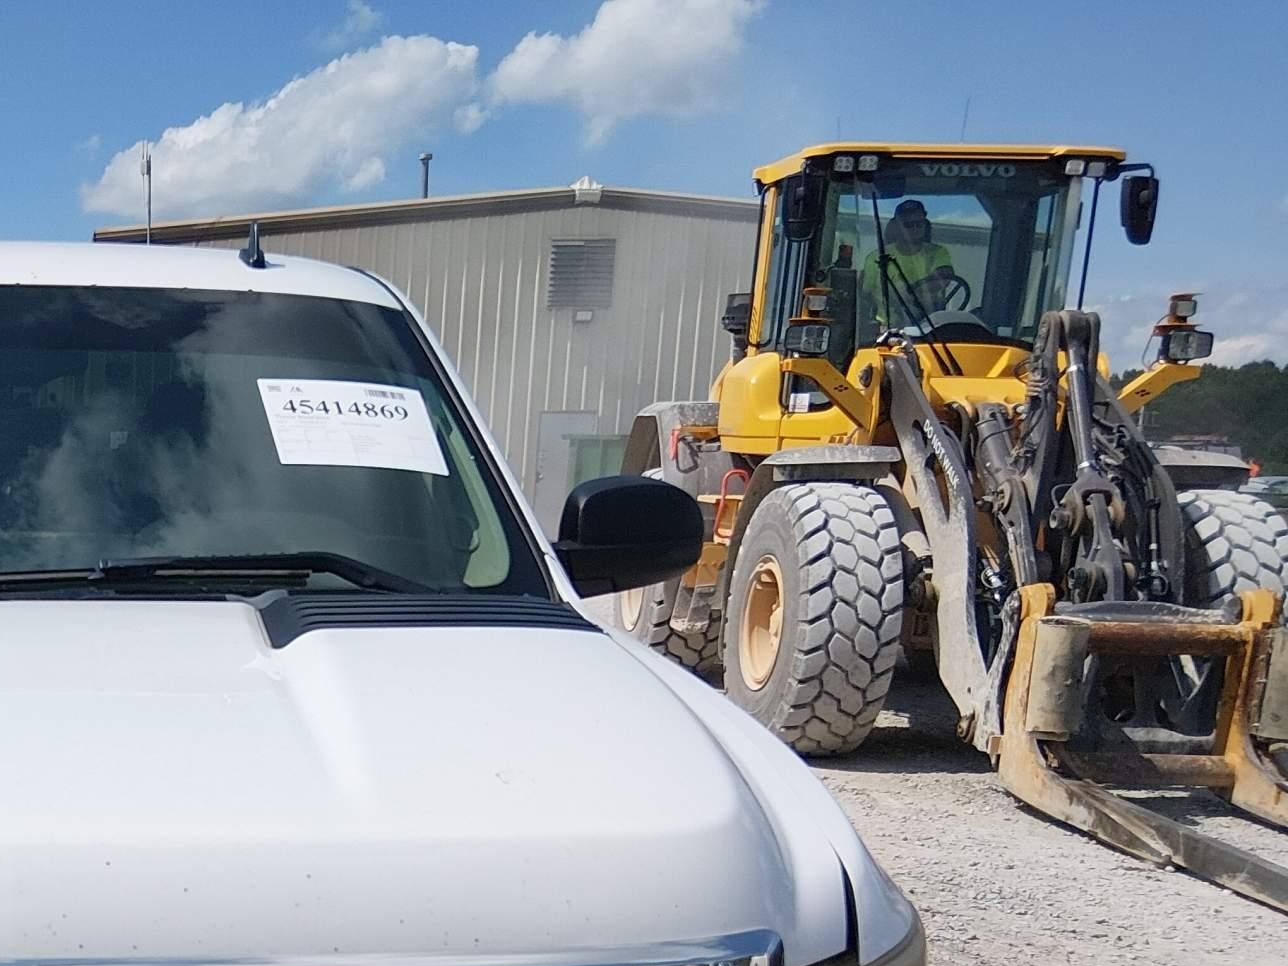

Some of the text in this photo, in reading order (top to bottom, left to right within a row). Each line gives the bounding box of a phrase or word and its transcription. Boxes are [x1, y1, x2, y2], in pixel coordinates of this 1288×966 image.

[919, 163, 1017, 178] VOLVO
[282, 399, 409, 421] 45414869
[923, 418, 960, 490] DO NOT WALK
